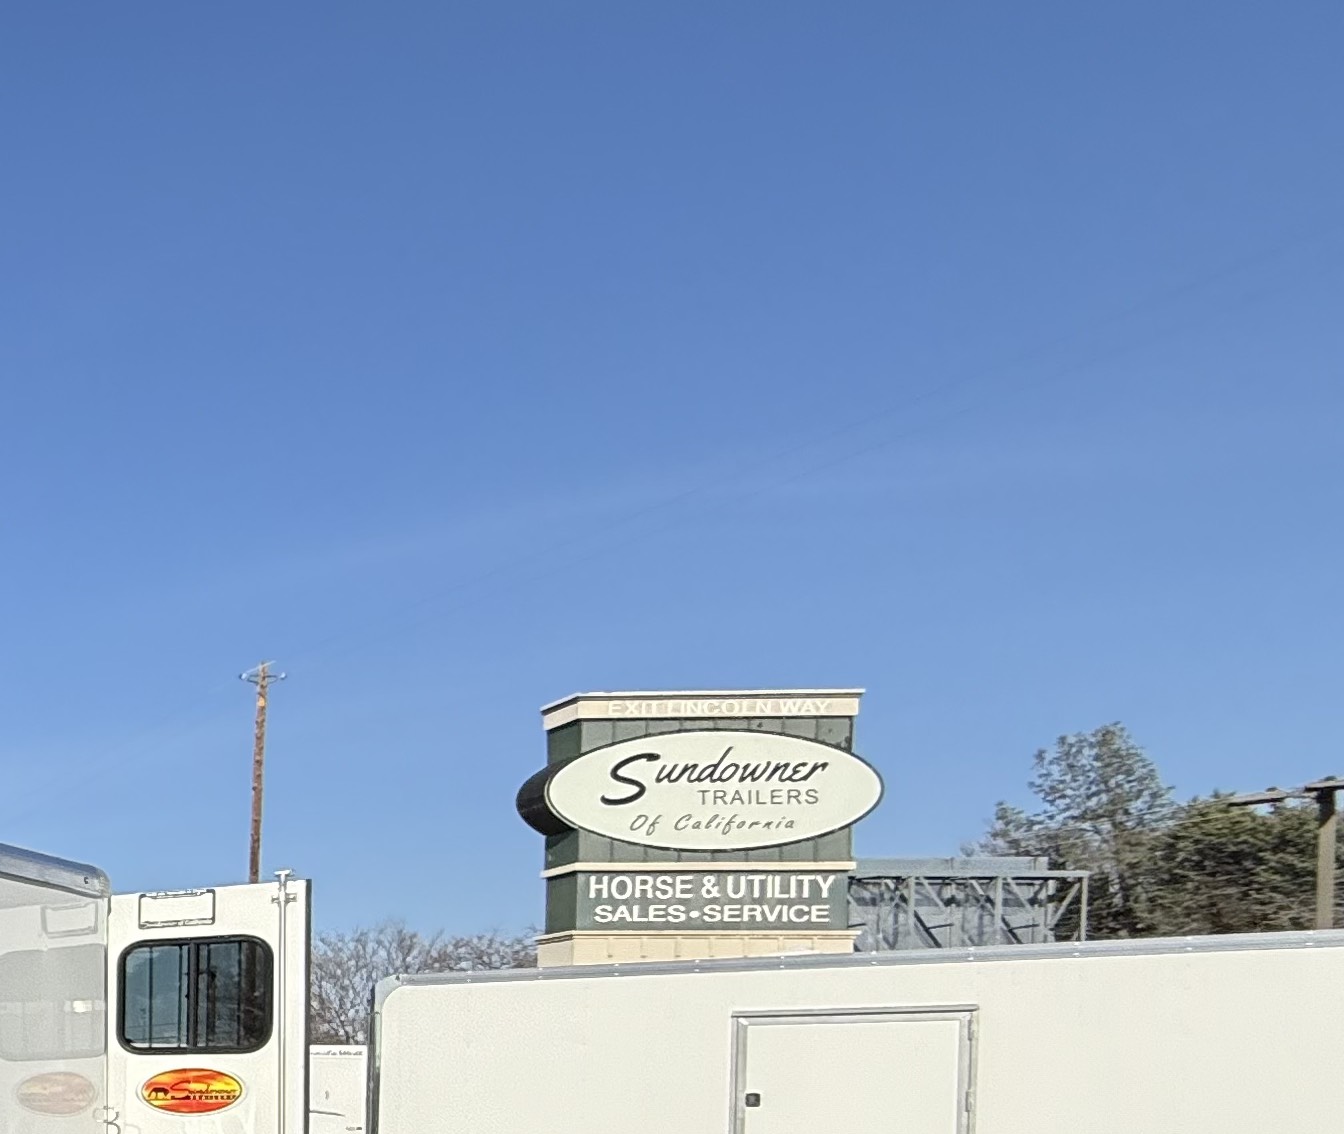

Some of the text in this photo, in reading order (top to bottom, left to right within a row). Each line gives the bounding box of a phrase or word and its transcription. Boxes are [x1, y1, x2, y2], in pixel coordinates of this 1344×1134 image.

[607, 700, 831, 716] EXIT LINCOLN WAY
[600, 746, 829, 806] Sundowner
[698, 789, 820, 806] TRAILERS
[629, 813, 796, 836] Of California
[588, 874, 836, 899] HORSE & UTILITY
